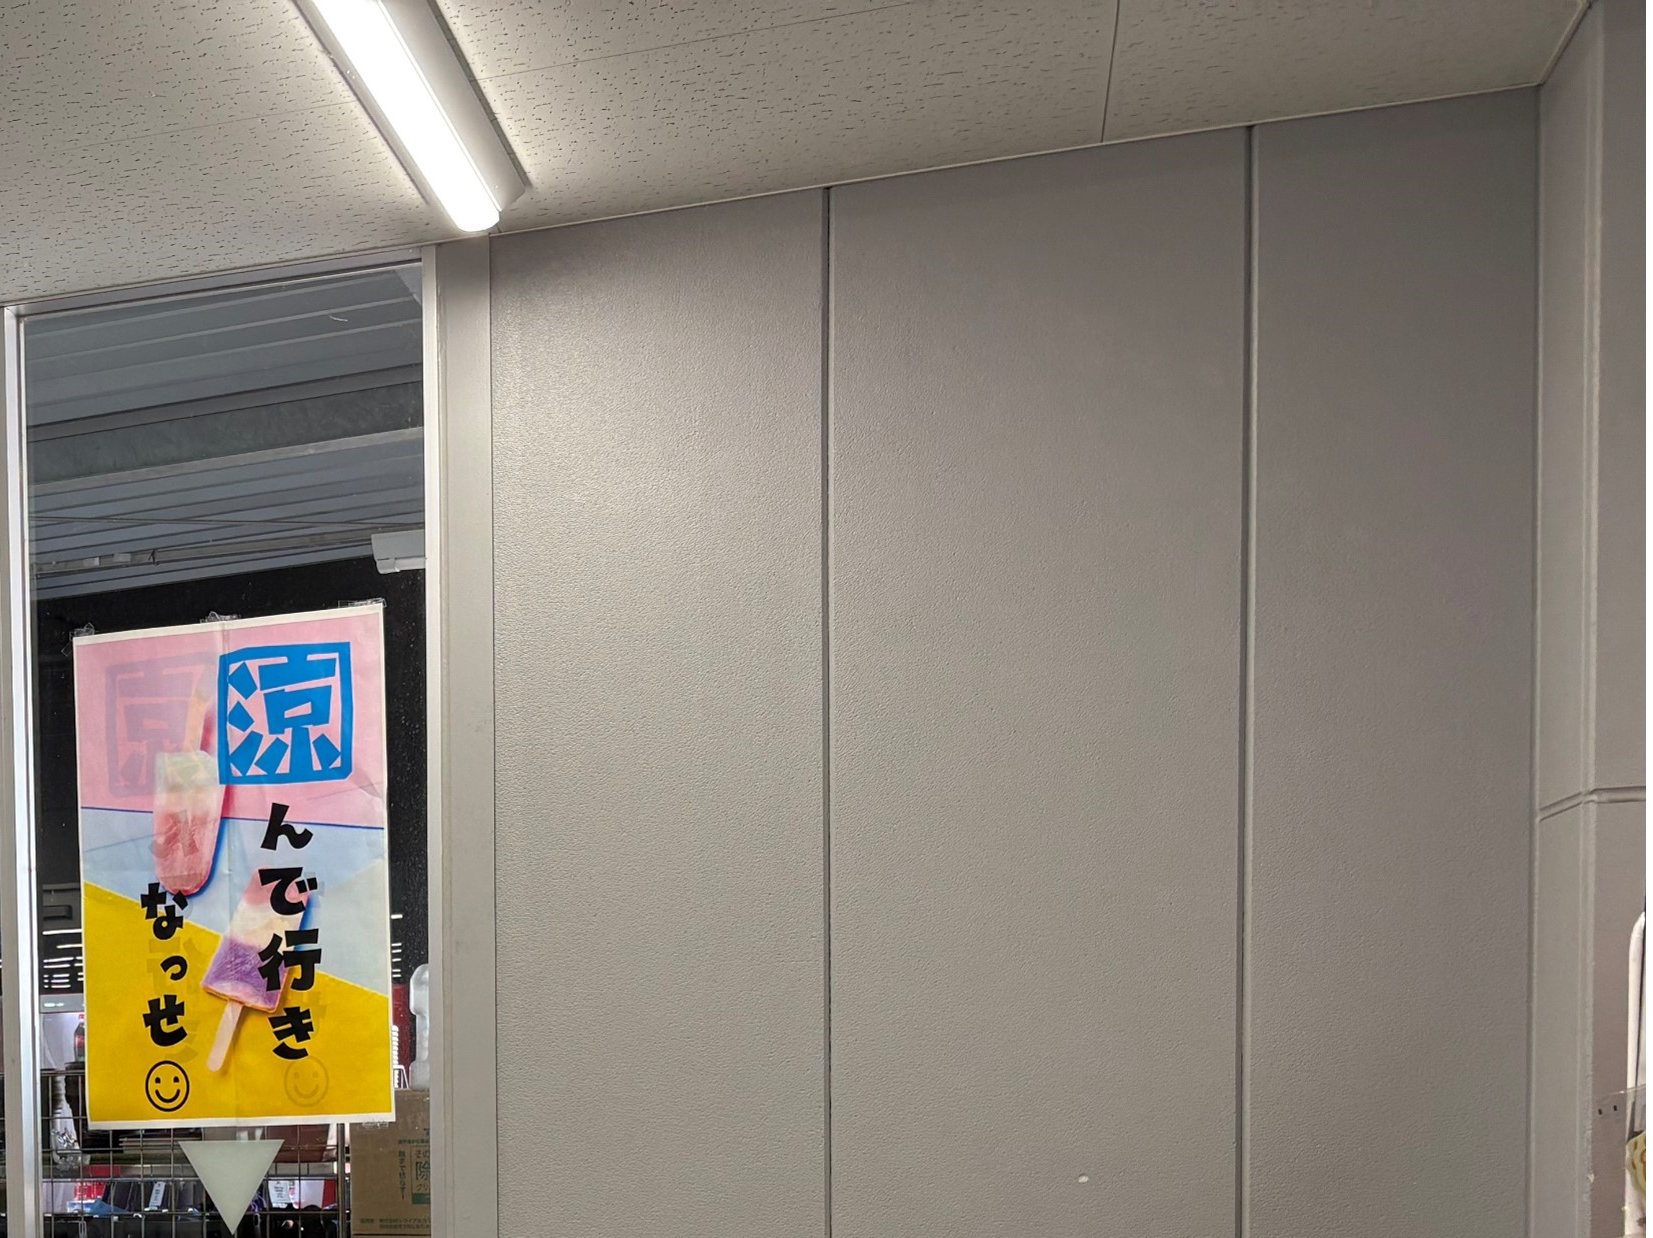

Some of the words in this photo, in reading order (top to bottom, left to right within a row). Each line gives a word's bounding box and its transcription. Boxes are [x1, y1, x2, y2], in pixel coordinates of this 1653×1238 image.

[220, 645, 350, 783] 涼
[141, 883, 189, 1047] なっせ
